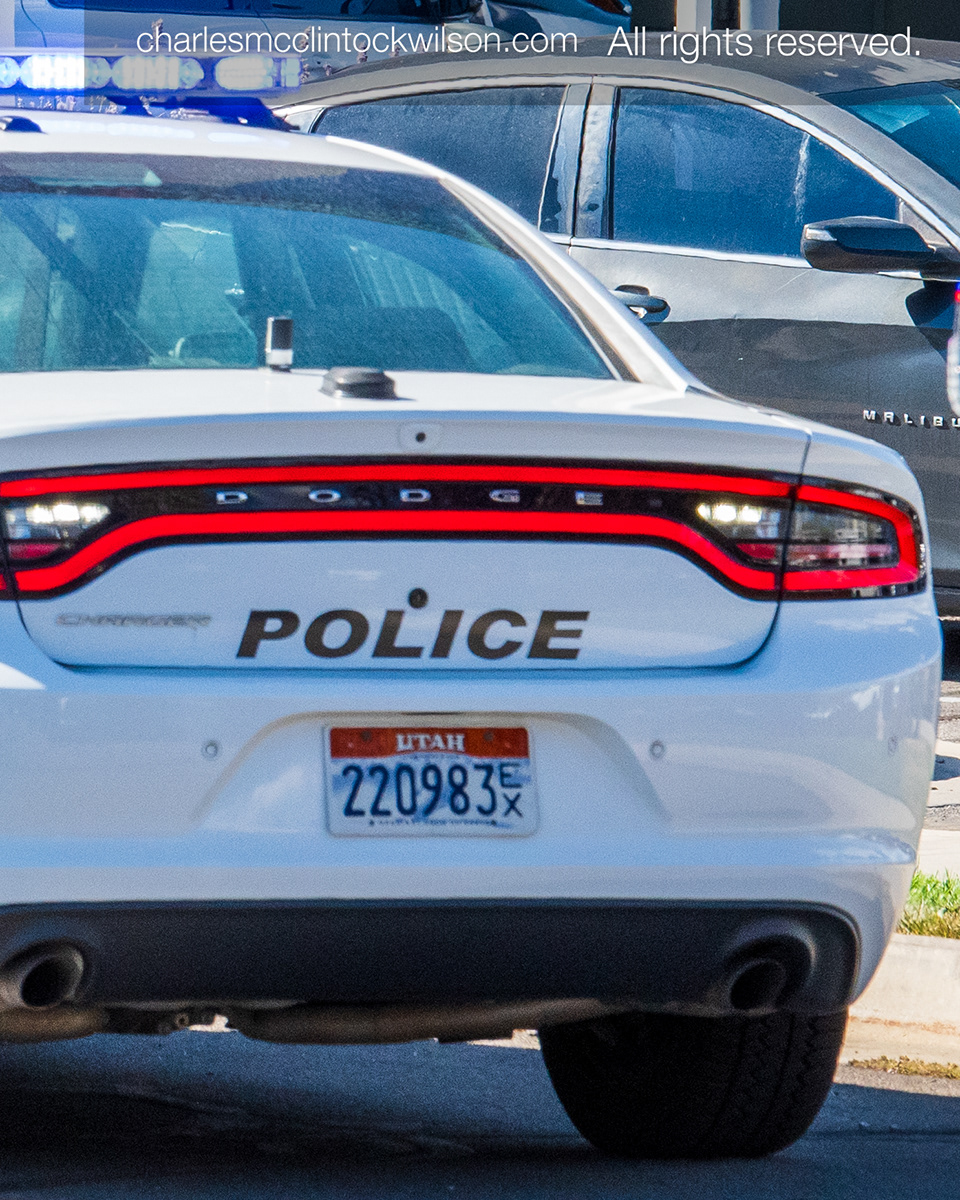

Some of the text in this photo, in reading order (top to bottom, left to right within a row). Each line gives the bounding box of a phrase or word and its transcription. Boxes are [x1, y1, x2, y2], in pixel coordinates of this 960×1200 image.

[863, 409, 960, 428] MALIBU
[216, 488, 604, 506] DODGE
[236, 609, 590, 660] POLICE
[396, 733, 465, 751] UTAH
